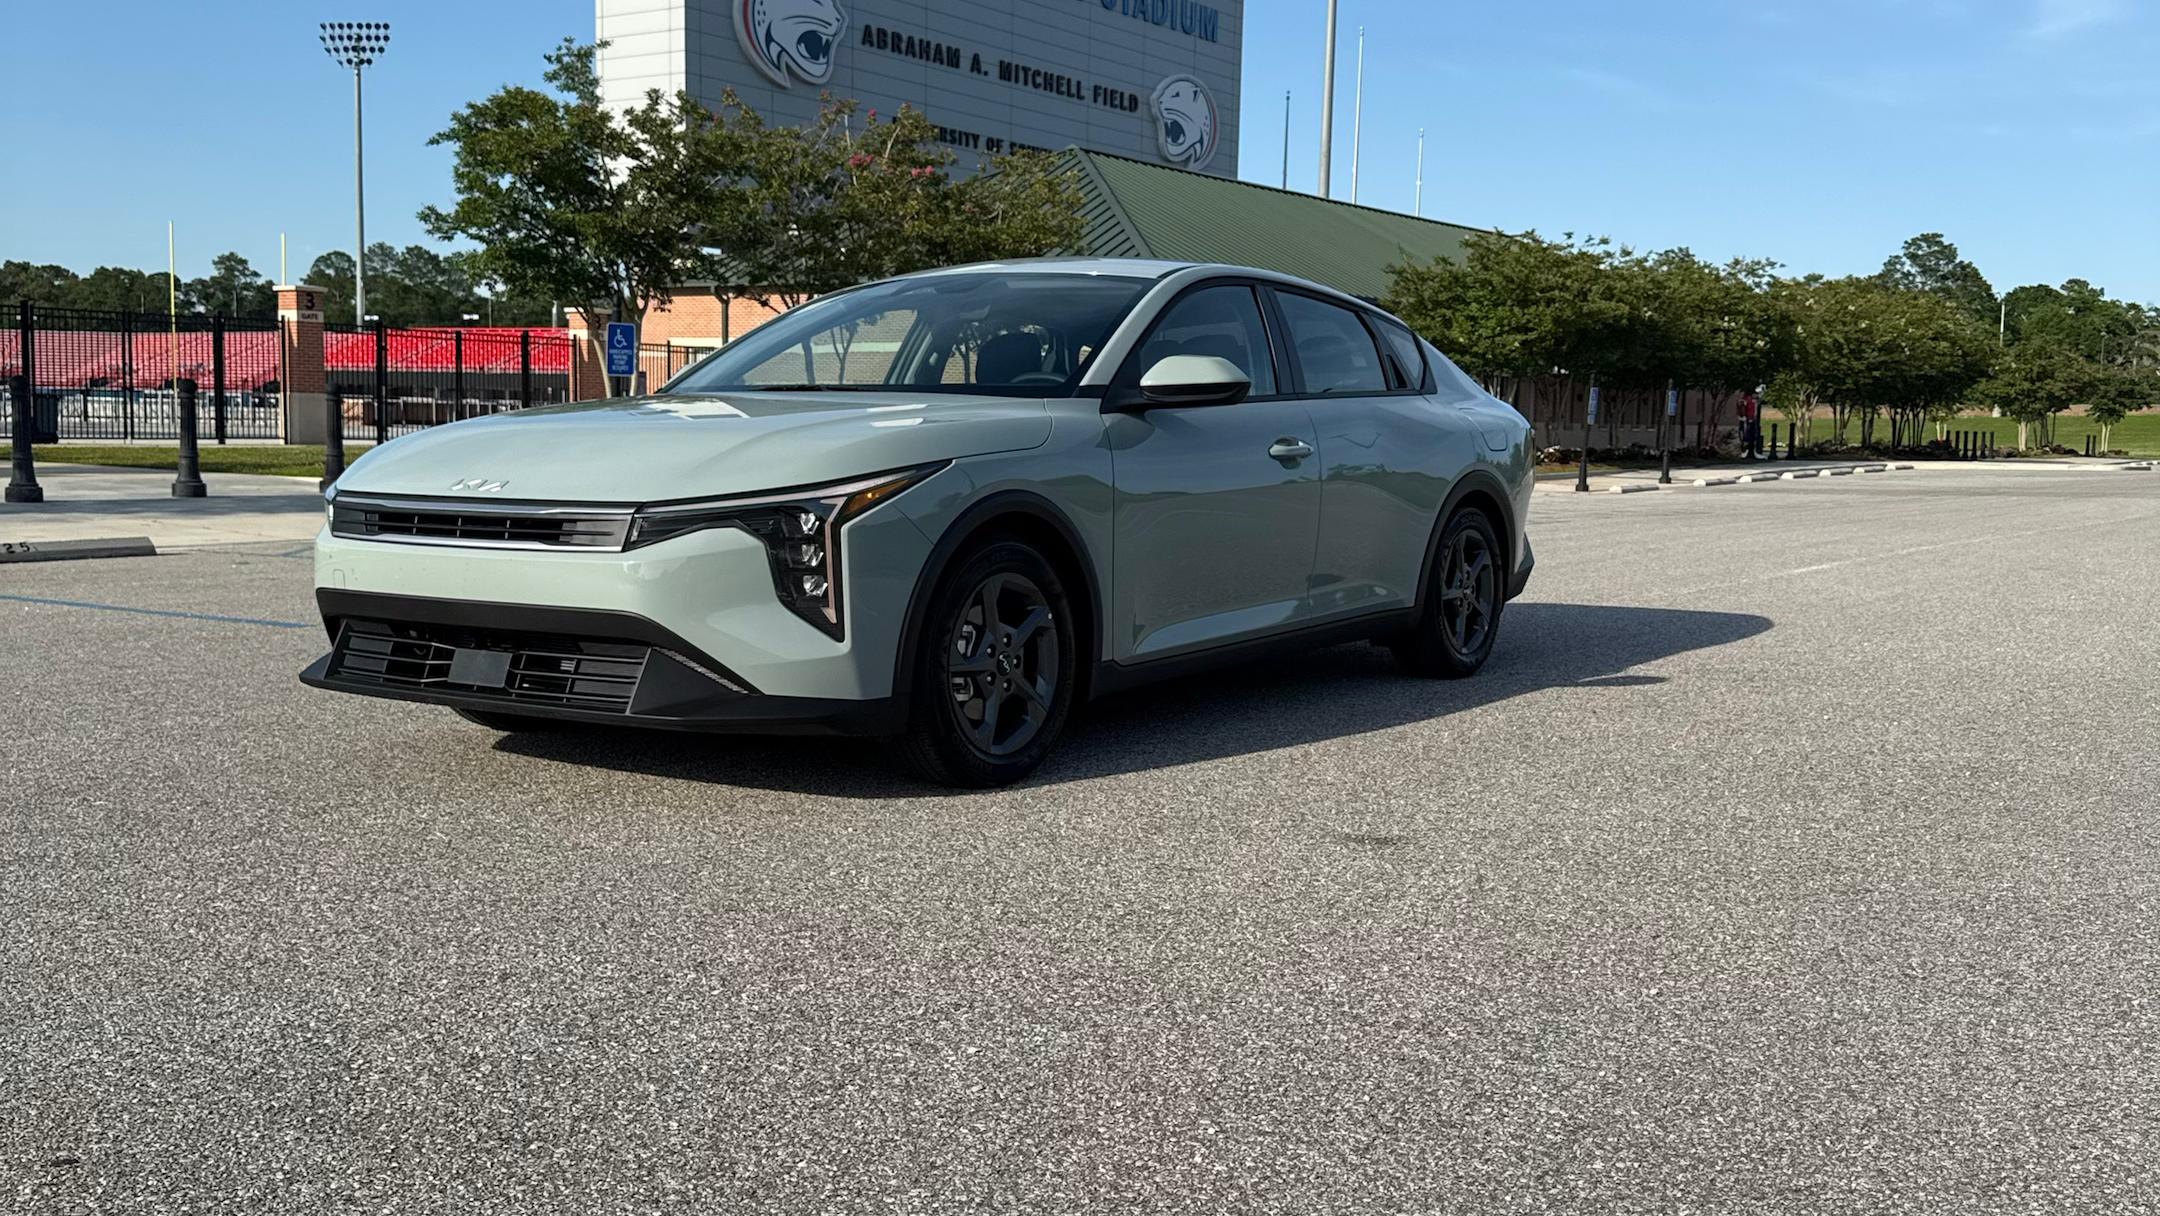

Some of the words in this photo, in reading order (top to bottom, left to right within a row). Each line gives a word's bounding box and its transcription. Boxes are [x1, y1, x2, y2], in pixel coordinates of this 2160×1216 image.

[1101, 0, 1219, 43] ADIUM
[861, 24, 961, 69] ABRAHAM
[970, 52, 989, 77] A.
[998, 59, 1085, 101] MITCHELL
[1092, 84, 1139, 113] FIELD
[986, 135, 1004, 153] OF
[304, 292, 315, 310] 3
